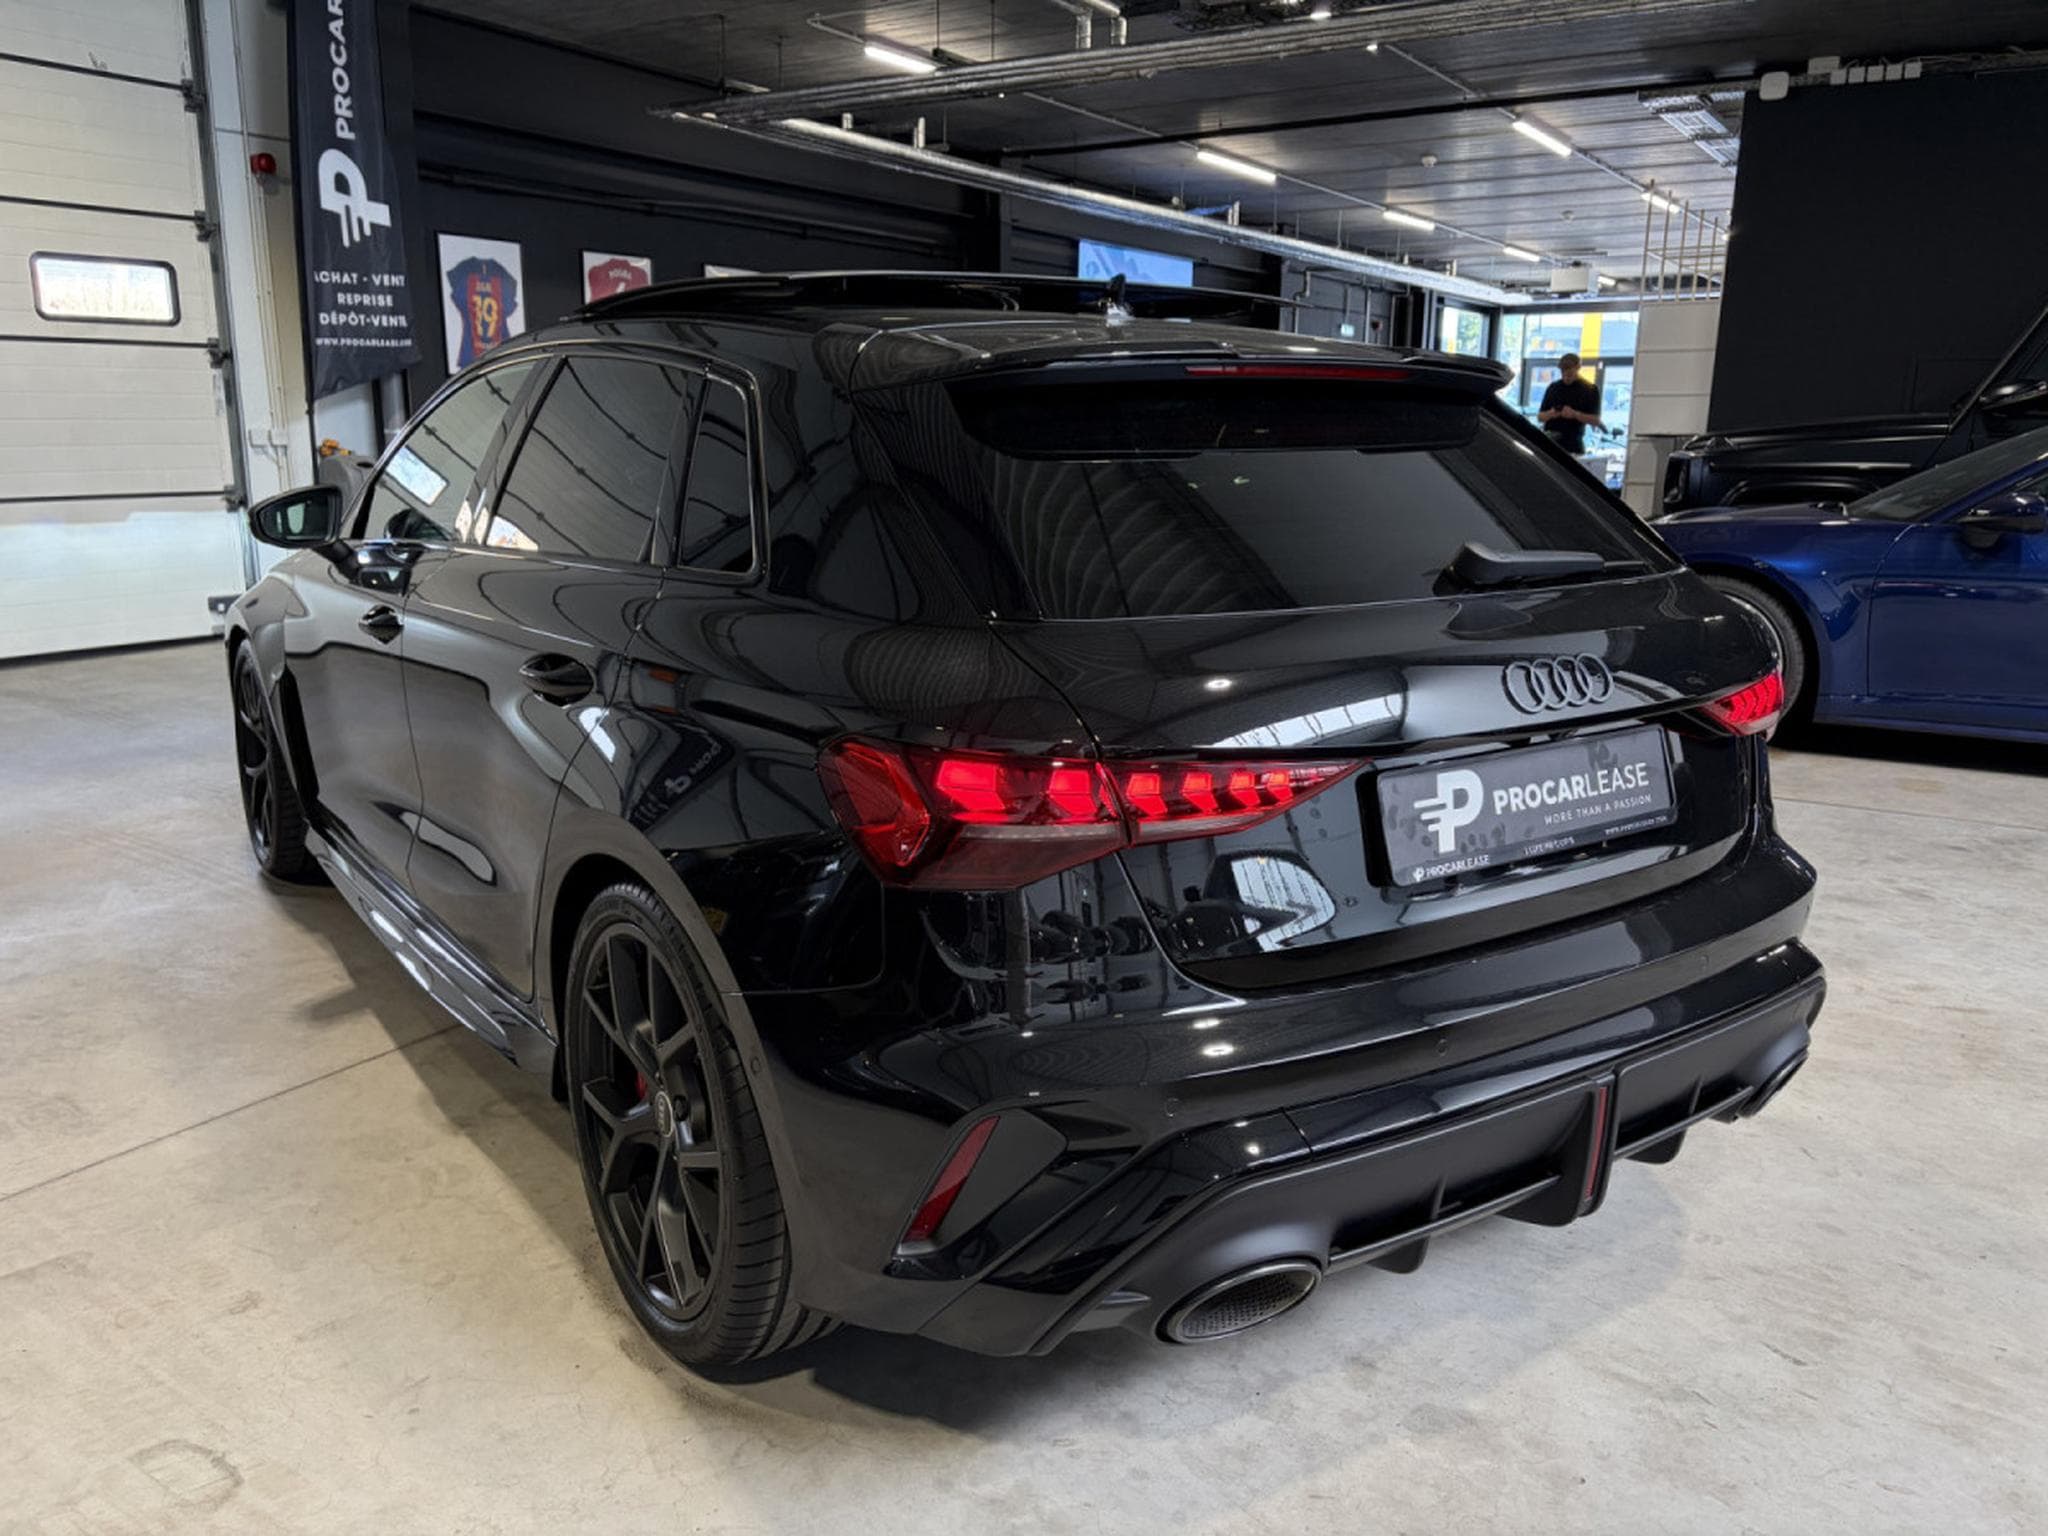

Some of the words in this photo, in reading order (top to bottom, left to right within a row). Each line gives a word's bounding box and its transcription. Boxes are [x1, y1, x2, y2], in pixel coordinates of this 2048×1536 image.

[337, 292, 393, 307] REPRISE
[471, 295, 498, 337] 19
[1493, 762, 1650, 815] PROCARLEASE
[1544, 812, 1573, 826] MORE
[1577, 804, 1602, 819] THAN
[1604, 800, 1612, 812] A
[1613, 794, 1652, 811] PASSION
